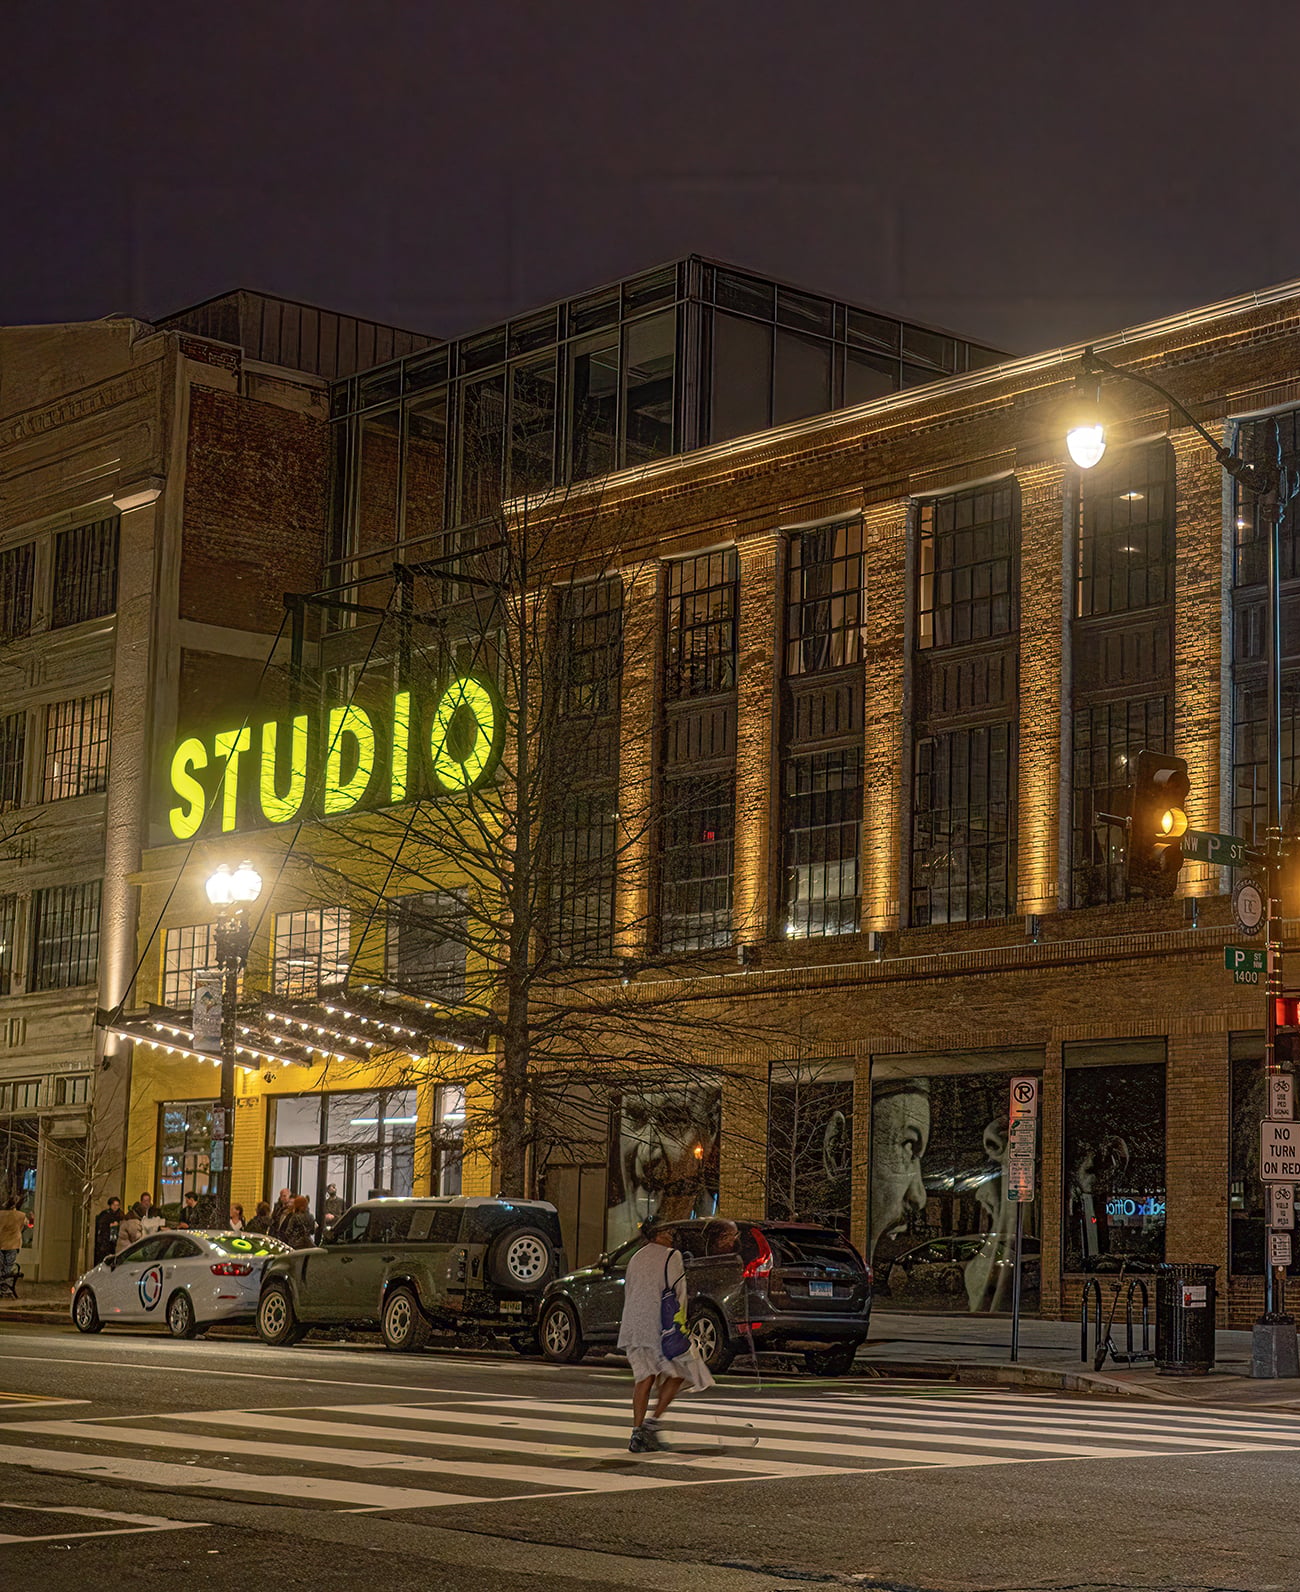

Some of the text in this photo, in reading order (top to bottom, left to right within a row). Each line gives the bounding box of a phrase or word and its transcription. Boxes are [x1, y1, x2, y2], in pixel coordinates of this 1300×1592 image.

[169, 677, 495, 840] STUDIO
[1184, 835, 1243, 859] NW P ST
[1235, 950, 1262, 967] P ST
[1234, 970, 1258, 983] 1400
[1274, 1128, 1290, 1141] NO
[1269, 1145, 1296, 1158] TURN
[1263, 1162, 1300, 1175] ON RED
